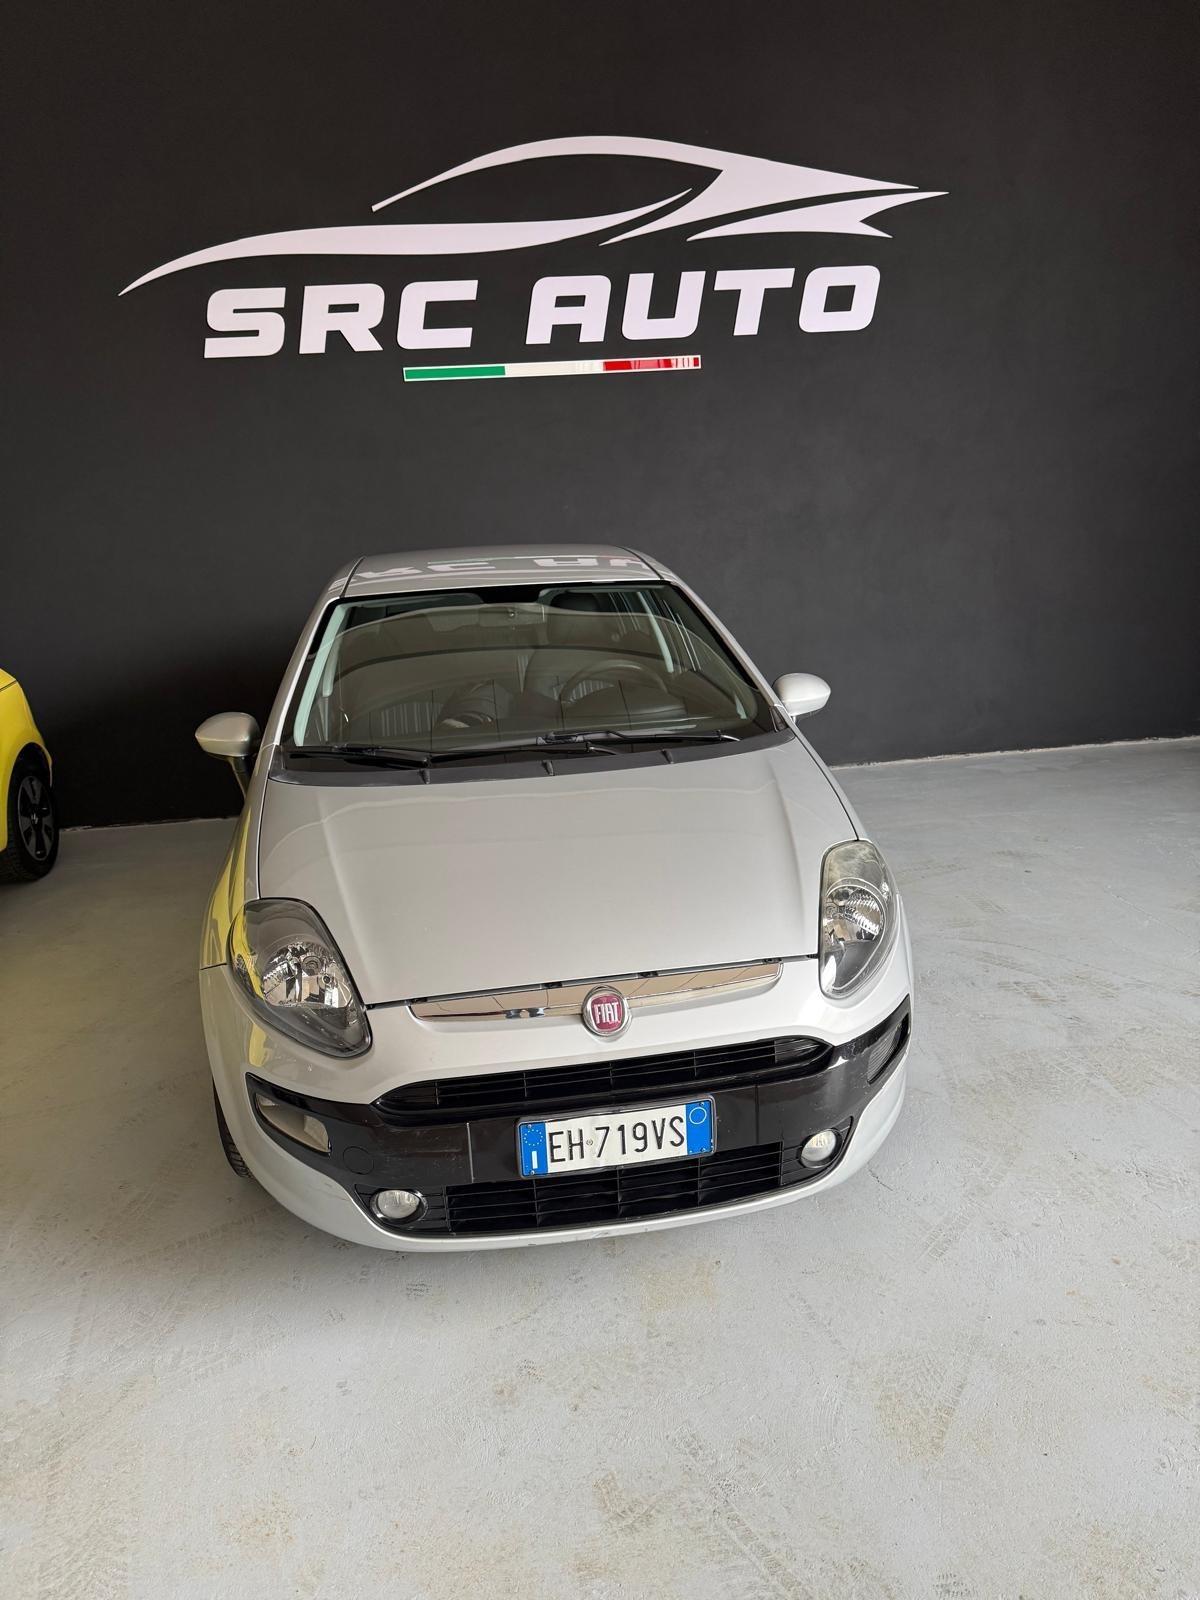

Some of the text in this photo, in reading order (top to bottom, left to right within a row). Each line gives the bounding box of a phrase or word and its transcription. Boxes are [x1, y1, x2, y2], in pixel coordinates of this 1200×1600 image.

[204, 265, 881, 358] SRC AUTO
[593, 1001, 621, 1025] FIAT
